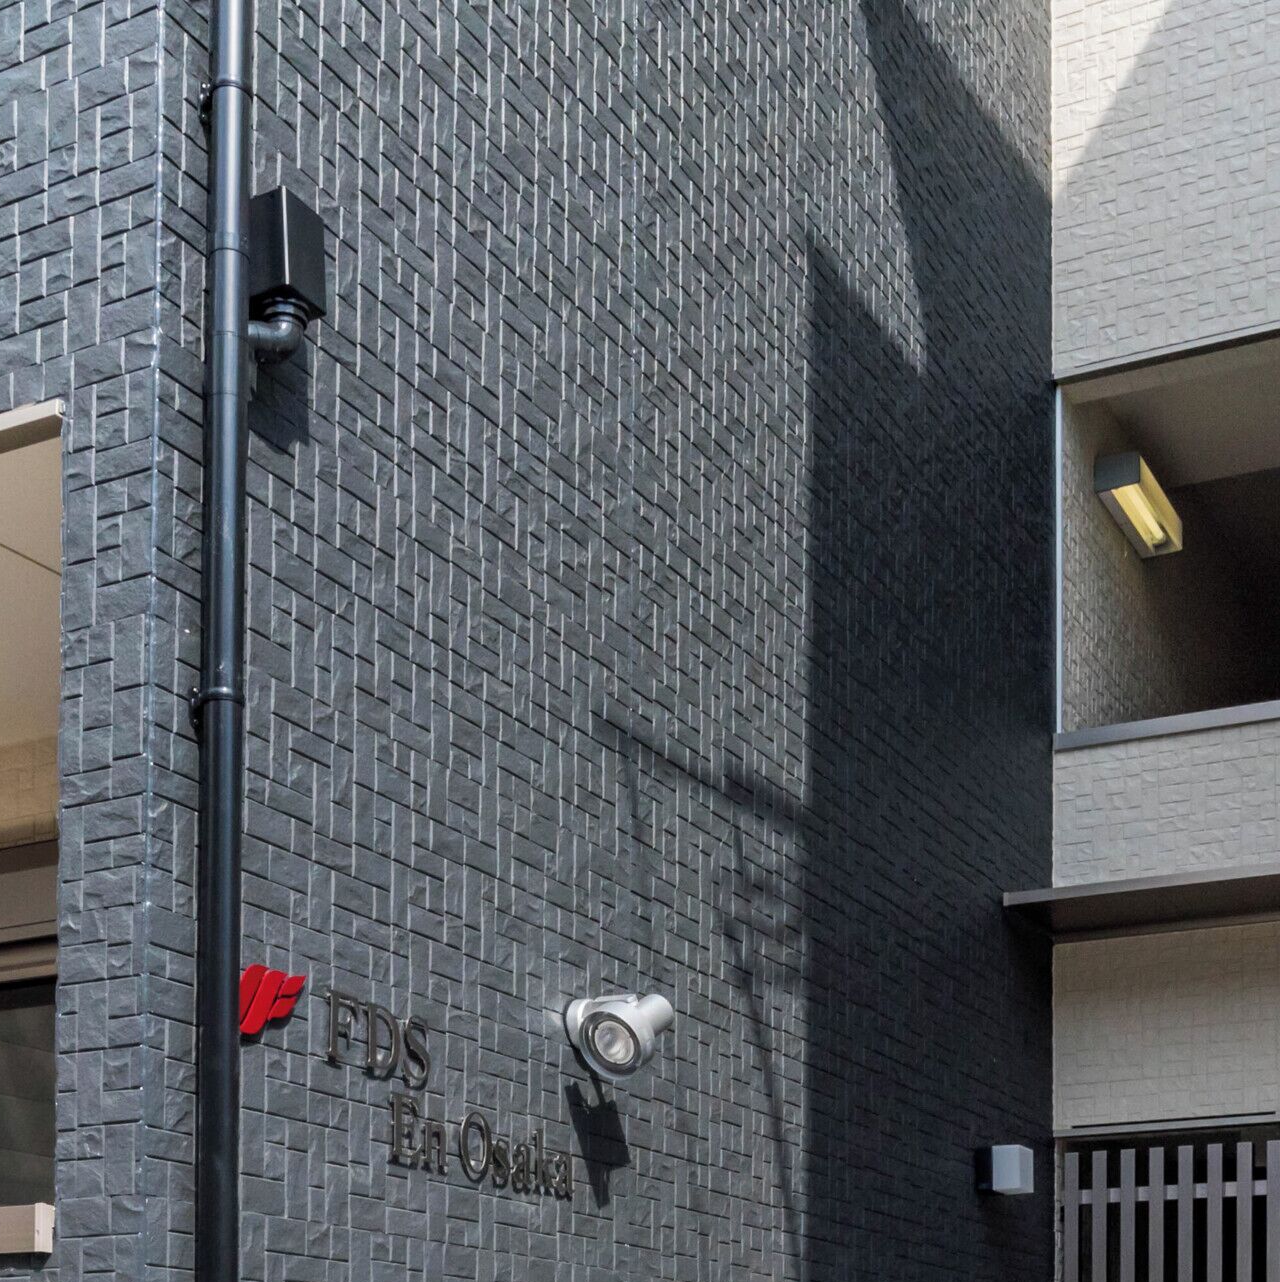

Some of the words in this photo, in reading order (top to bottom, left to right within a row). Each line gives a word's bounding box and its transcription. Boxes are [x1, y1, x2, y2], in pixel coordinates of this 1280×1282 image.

[326, 989, 431, 1088] FDS
[390, 1091, 448, 1177] En
[458, 1110, 575, 1201] Osaka
